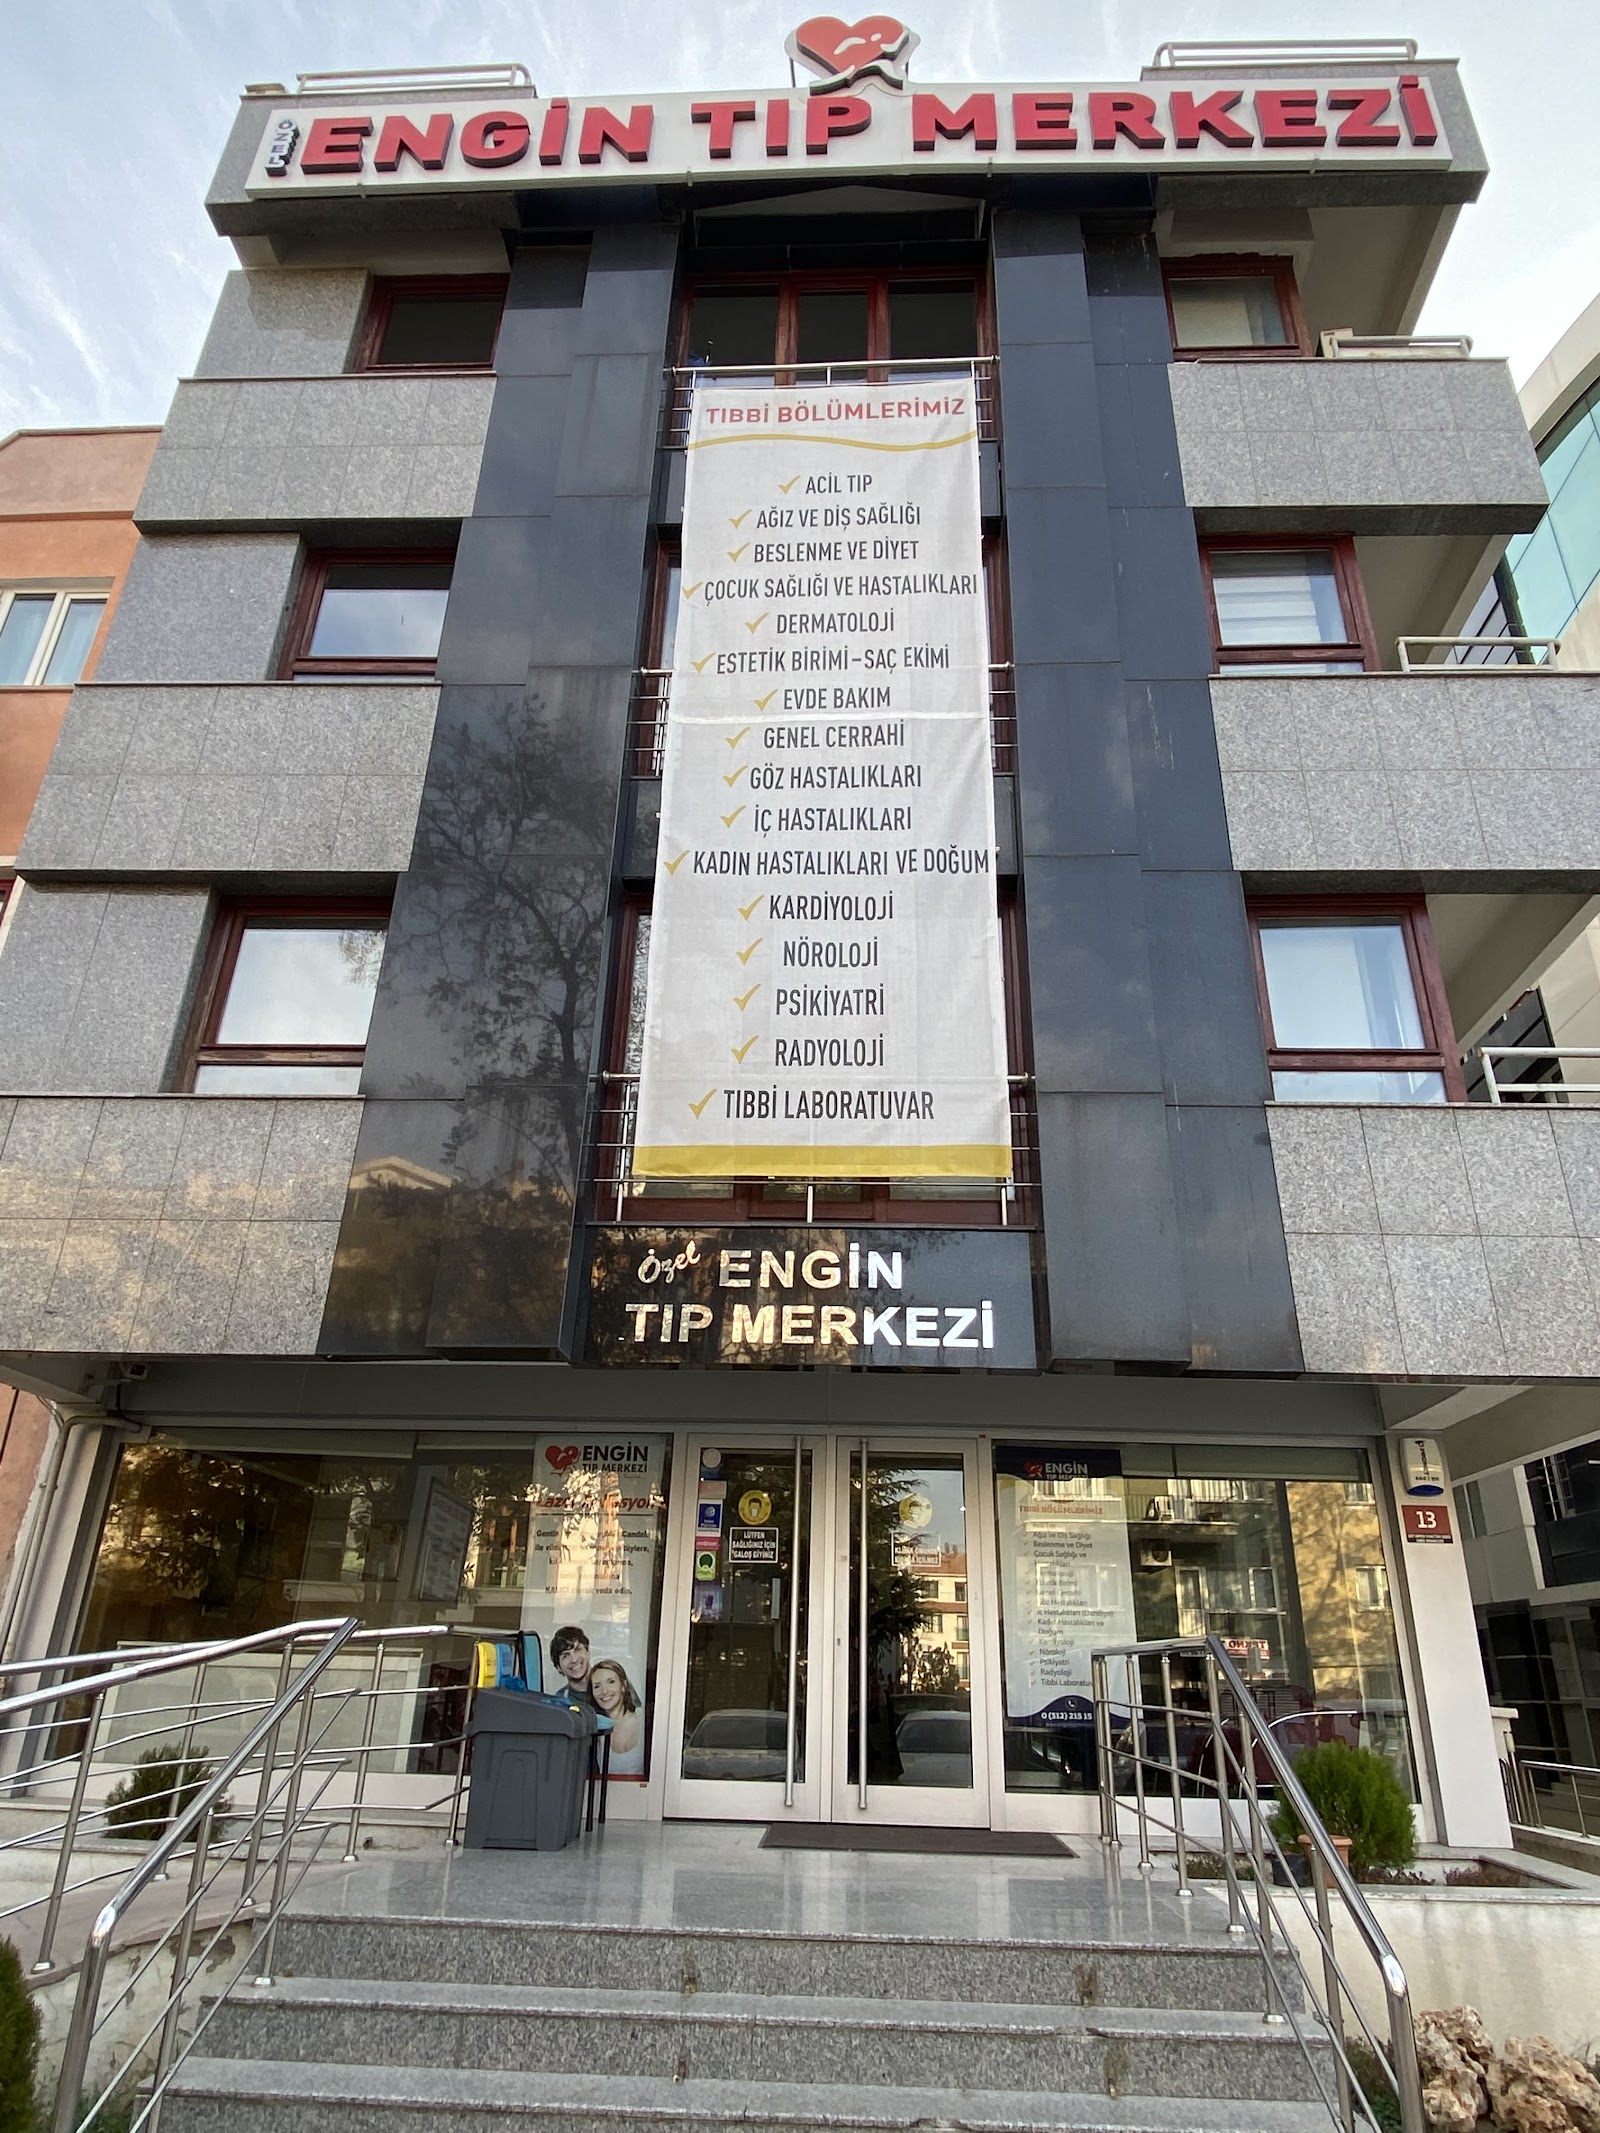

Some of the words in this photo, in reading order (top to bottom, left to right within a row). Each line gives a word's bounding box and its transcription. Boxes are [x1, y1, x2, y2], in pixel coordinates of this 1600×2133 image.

[300, 98, 654, 174] ENGİN
[690, 97, 872, 159] TIP
[912, 75, 1438, 151] MERKEZİ
[706, 403, 769, 425] TIBBİ
[778, 397, 965, 423] BÖLÜMLERİMİZ
[805, 472, 842, 495] ACİL
[847, 474, 873, 493] TIP
[756, 507, 794, 529] AĞIZ
[799, 509, 818, 528] VE
[824, 504, 851, 531] DİŞ
[856, 501, 921, 526] SAĞLIĞI
[754, 542, 842, 563] BESLENME
[848, 542, 868, 561] VE
[873, 540, 919, 561] DİYET
[704, 579, 760, 605] ÇOCUK
[764, 573, 830, 599] SAĞLIĞI
[834, 576, 854, 596] VE
[859, 574, 978, 596] HASTALIKLARI
[776, 608, 894, 634] DERMATOLOJİ
[716, 647, 785, 675] ESTETİK
[903, 643, 950, 670] EKİMİ
[783, 688, 827, 710] EVDE
[833, 686, 891, 708] BAKIM
[763, 727, 820, 750] GENEL
[825, 723, 905, 748] CERRAHİ
[750, 763, 784, 790] GÖZ
[790, 764, 922, 789] HASTALIKLARI
[754, 804, 772, 838] İÇ
[778, 806, 912, 832] HASTALIKLARI
[693, 850, 750, 876] KADIN
[756, 851, 888, 876] HASTALIKLARI
[896, 848, 919, 873] VE
[924, 843, 989, 875] DOĞUM
[769, 890, 894, 921] KARDİYOLOJİ
[783, 935, 879, 968] NÖROLOJİ
[775, 985, 885, 1016] PSİKİYATRİ
[774, 1034, 885, 1068] RADYOLOJİ
[723, 1084, 778, 1120] TIBBİ
[784, 1090, 935, 1121] LABORATUVAR
[637, 1239, 701, 1284] Özel
[718, 1242, 903, 1290] ENGİN
[624, 1303, 714, 1343] TIP
[731, 1299, 995, 1349] MERKEZİ
[582, 1441, 649, 1461] ENGİN
[601, 1462, 648, 1473] MERKEZİ
[1045, 1461, 1088, 1474] ENGİN
[744, 1530, 765, 1539] LÜTFEN
[1416, 1511, 1437, 1529] 13
